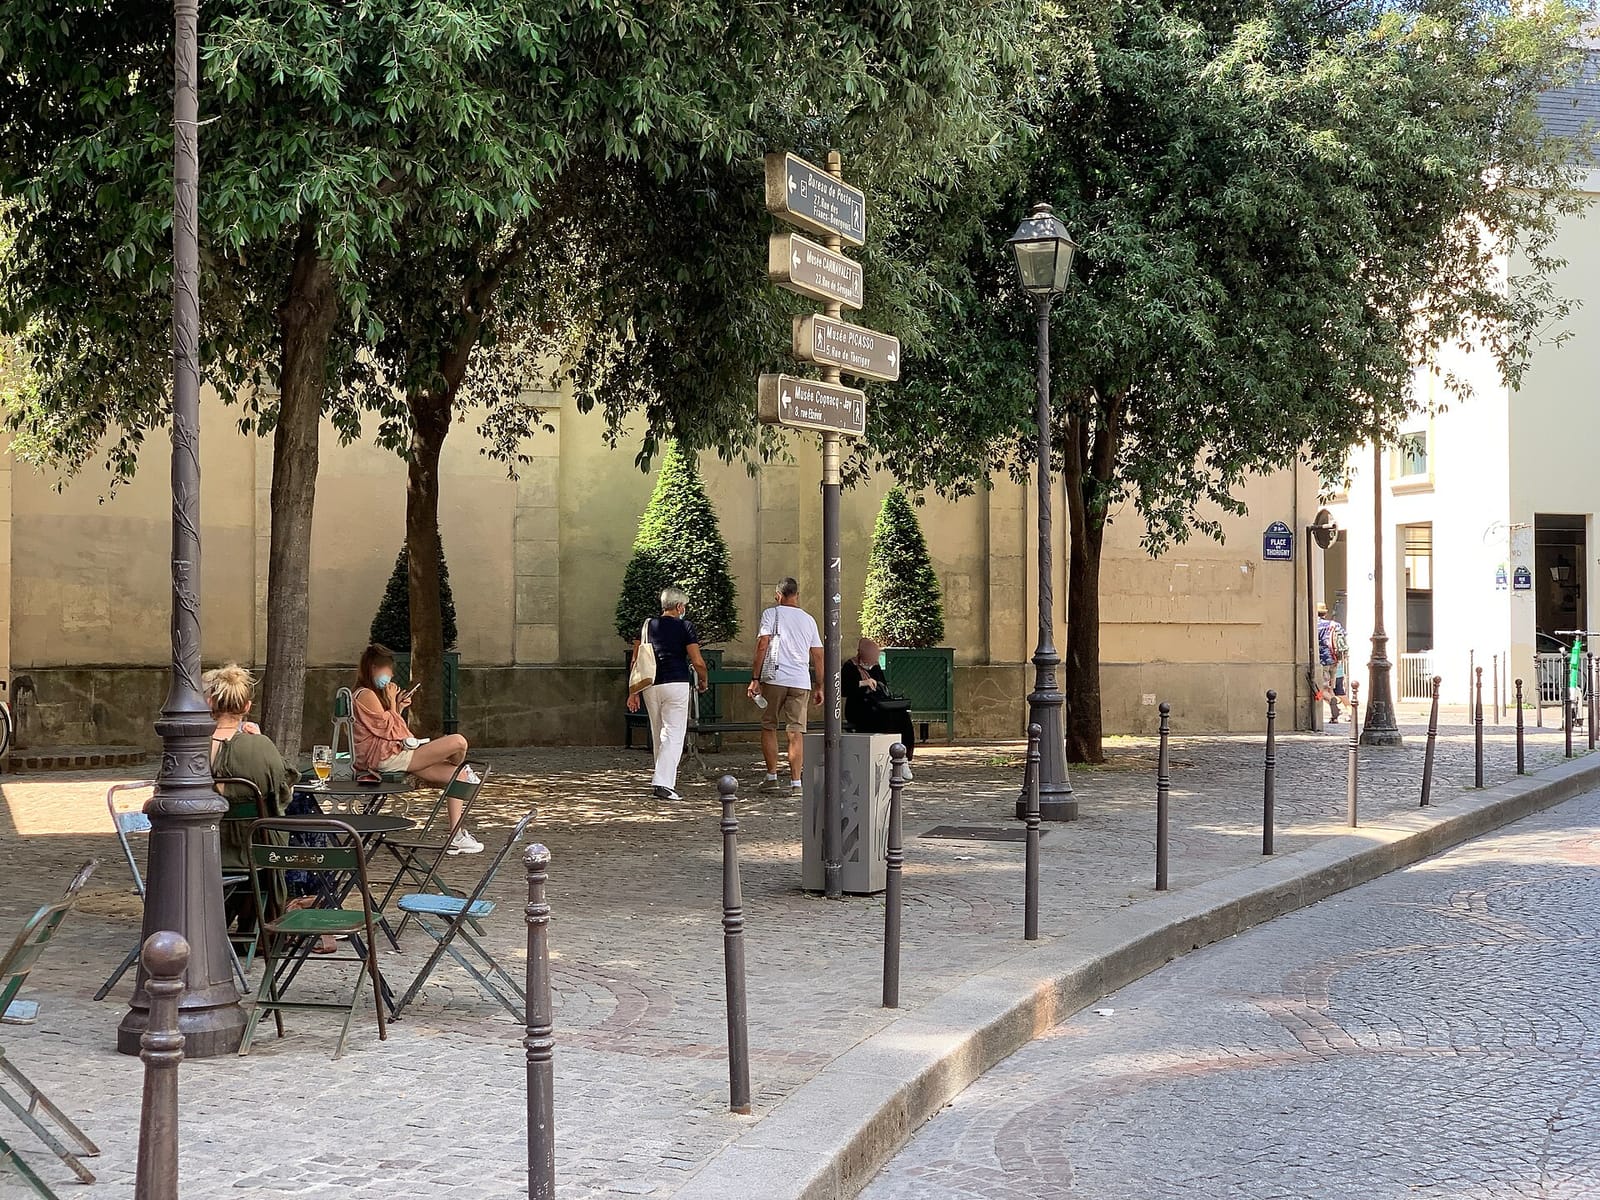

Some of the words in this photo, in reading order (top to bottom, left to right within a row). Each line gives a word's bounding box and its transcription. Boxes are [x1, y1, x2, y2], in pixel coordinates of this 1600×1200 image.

[808, 174, 828, 194] Bureau
[828, 184, 836, 198] de
[837, 188, 851, 206] Poste
[830, 202, 838, 214] des
[806, 250, 822, 268] Musée
[822, 258, 852, 280] CARNAVALET
[830, 280, 836, 290] de
[826, 325, 847, 344] Musée
[848, 331, 874, 350] PICASSO
[842, 350, 849, 360] de
[850, 352, 871, 368] Thorigny
[794, 386, 814, 402] Musée
